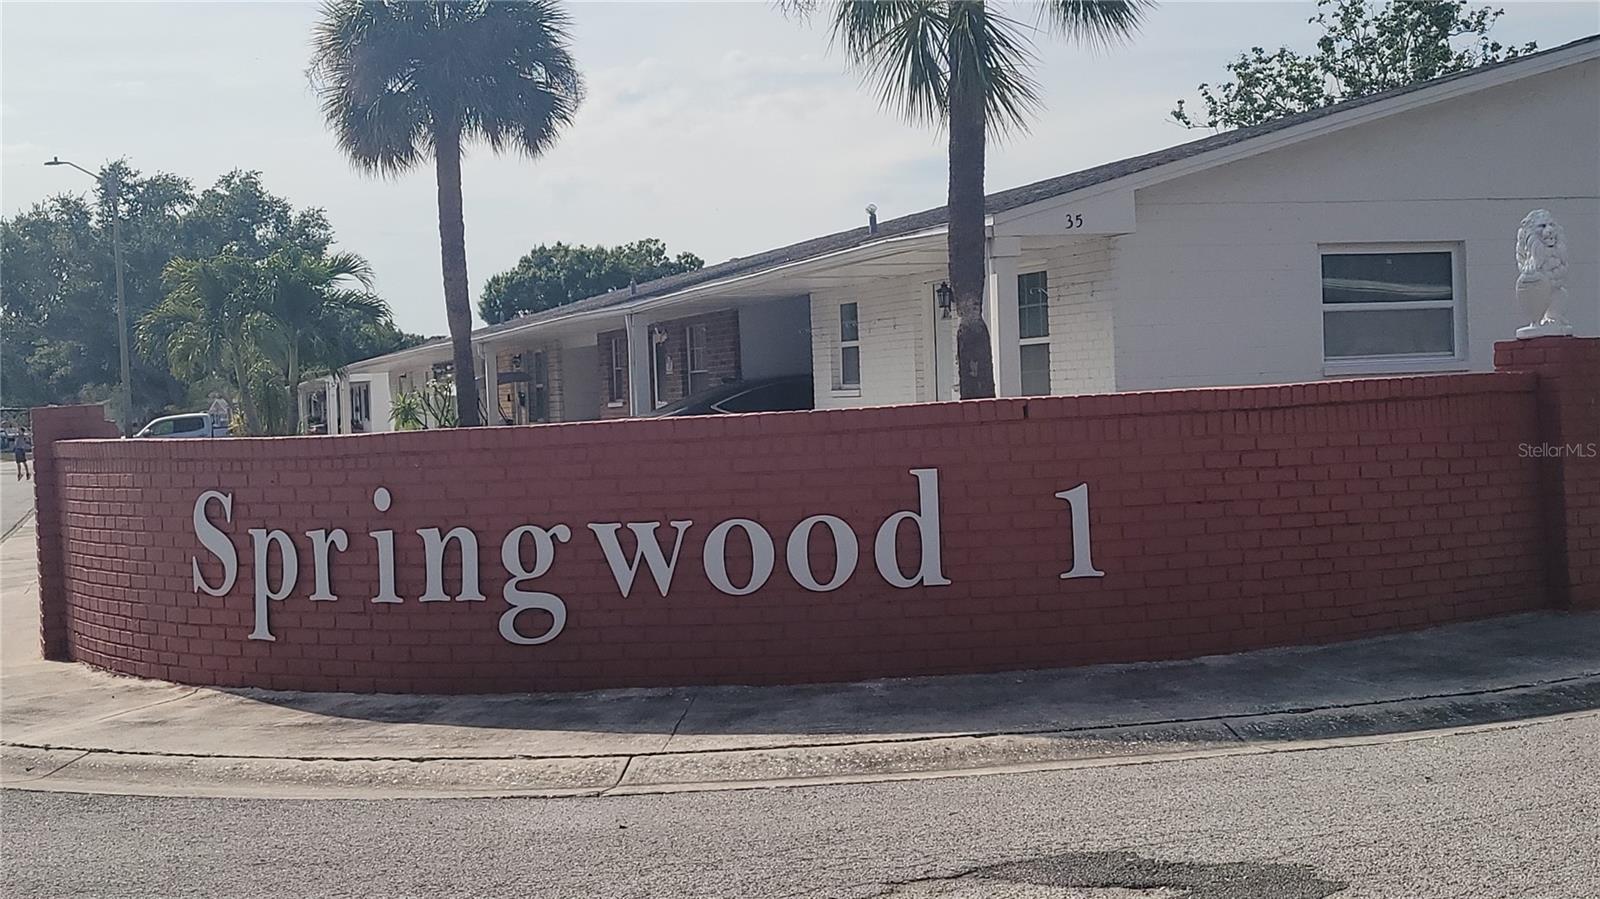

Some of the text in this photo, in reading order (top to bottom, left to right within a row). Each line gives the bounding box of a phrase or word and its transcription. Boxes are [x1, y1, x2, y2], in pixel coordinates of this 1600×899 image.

[1065, 213, 1083, 230] 35
[192, 468, 1105, 645] Springwood 1
